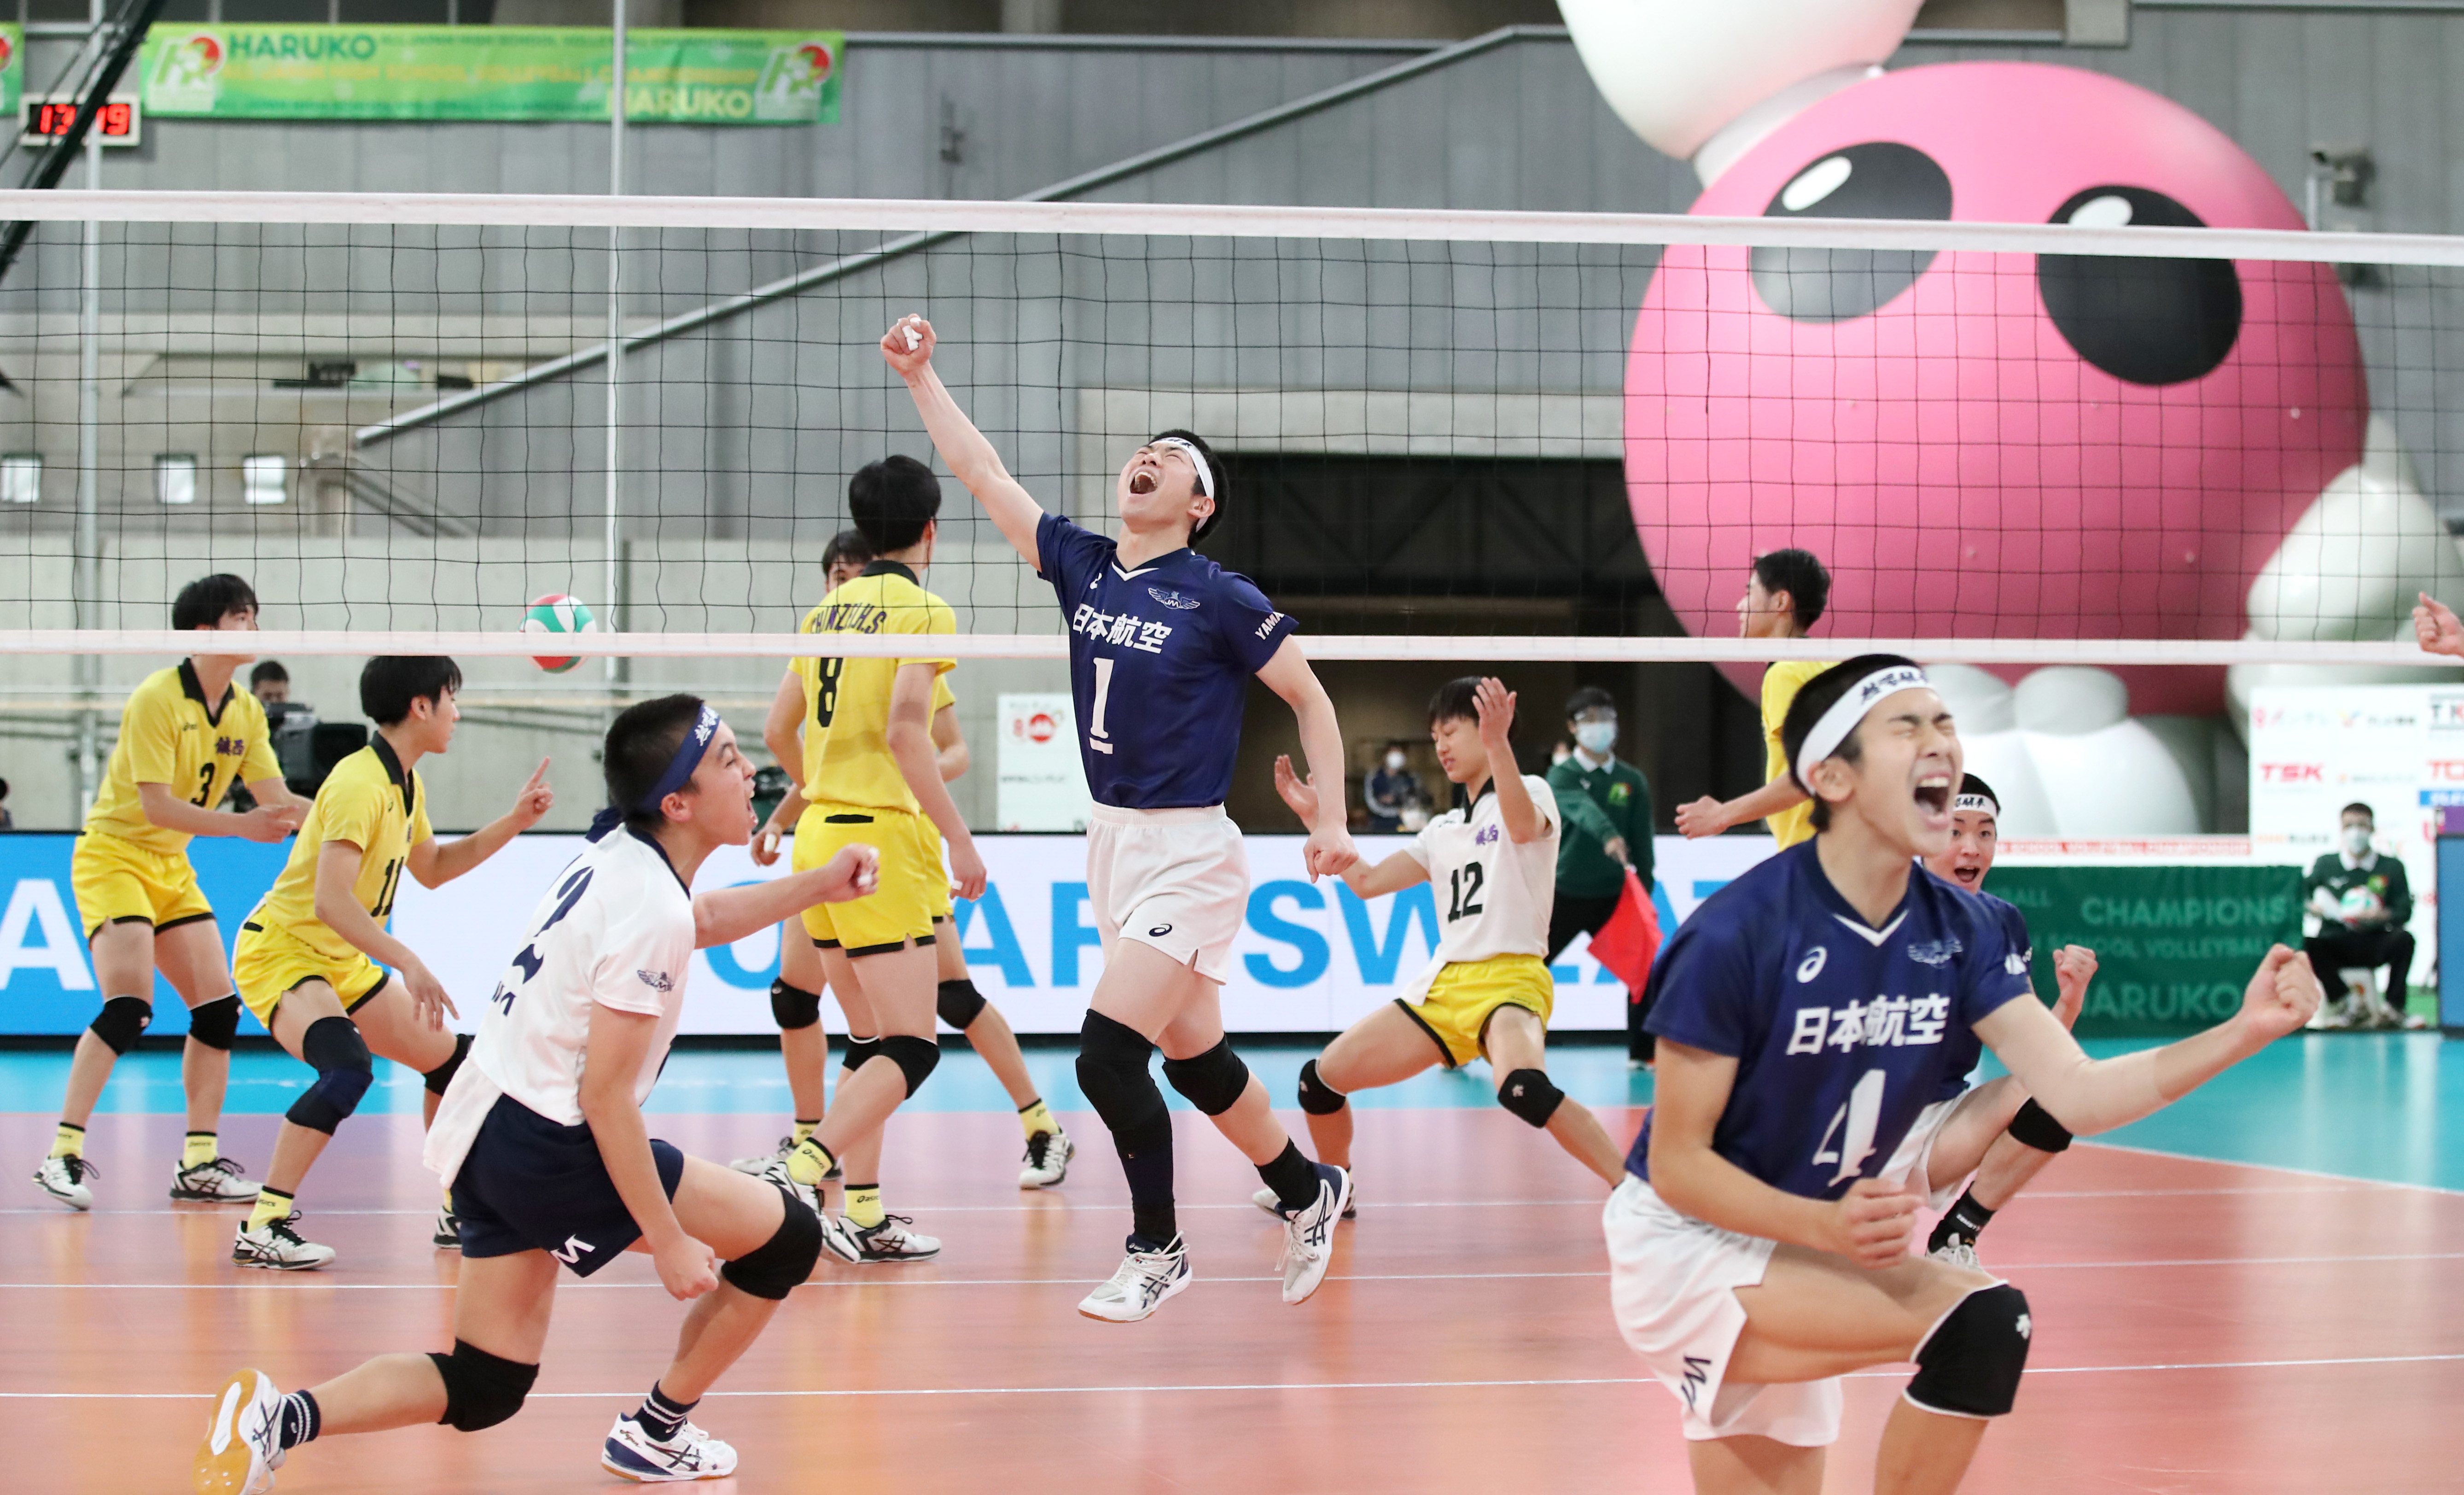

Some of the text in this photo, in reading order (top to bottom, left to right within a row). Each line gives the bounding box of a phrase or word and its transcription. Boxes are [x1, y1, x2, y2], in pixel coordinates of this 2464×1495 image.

[229, 34, 376, 60] HARUKO
[1073, 603, 1172, 654] 日本航空
[817, 657, 843, 728] 8
[1089, 657, 1114, 739] 1
[191, 763, 215, 806] 3
[2260, 762, 2324, 783] TSK
[370, 857, 404, 917] 11
[1448, 862, 1483, 923] 12
[1786, 993, 1951, 1055] 日本航空
[2085, 981, 2242, 1021] ARUKO
[1812, 1068, 1887, 1187] 4
